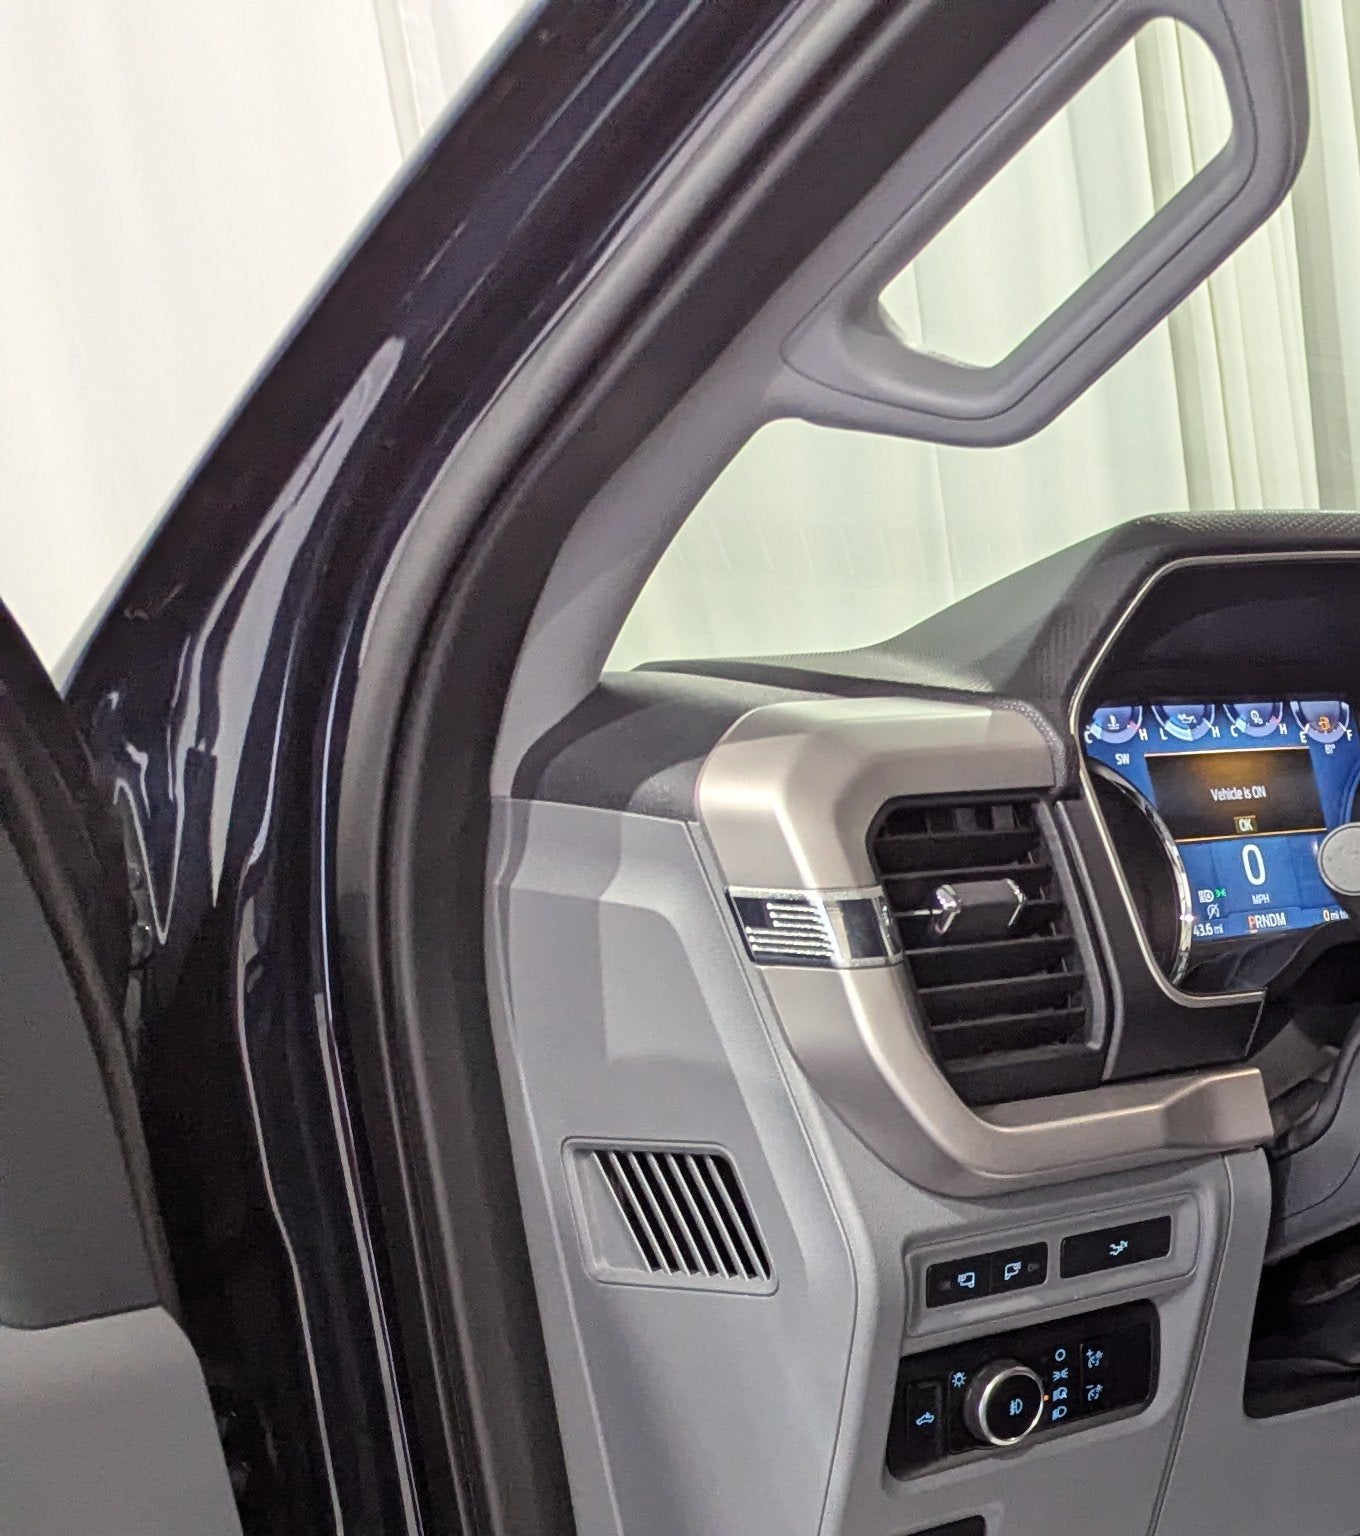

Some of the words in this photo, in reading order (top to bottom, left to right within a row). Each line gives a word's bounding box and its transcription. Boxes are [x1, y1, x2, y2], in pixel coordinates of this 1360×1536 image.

[1139, 728, 1149, 741] H
[1160, 728, 1168, 740] L
[1212, 725, 1220, 738] H
[1230, 725, 1239, 737] C
[1279, 723, 1288, 735] H
[1210, 786, 1243, 801] Vehicle
[1251, 785, 1267, 799] ON
[1238, 818, 1254, 832] OK
[1242, 844, 1266, 886] 0
[1251, 893, 1270, 905] MPH
